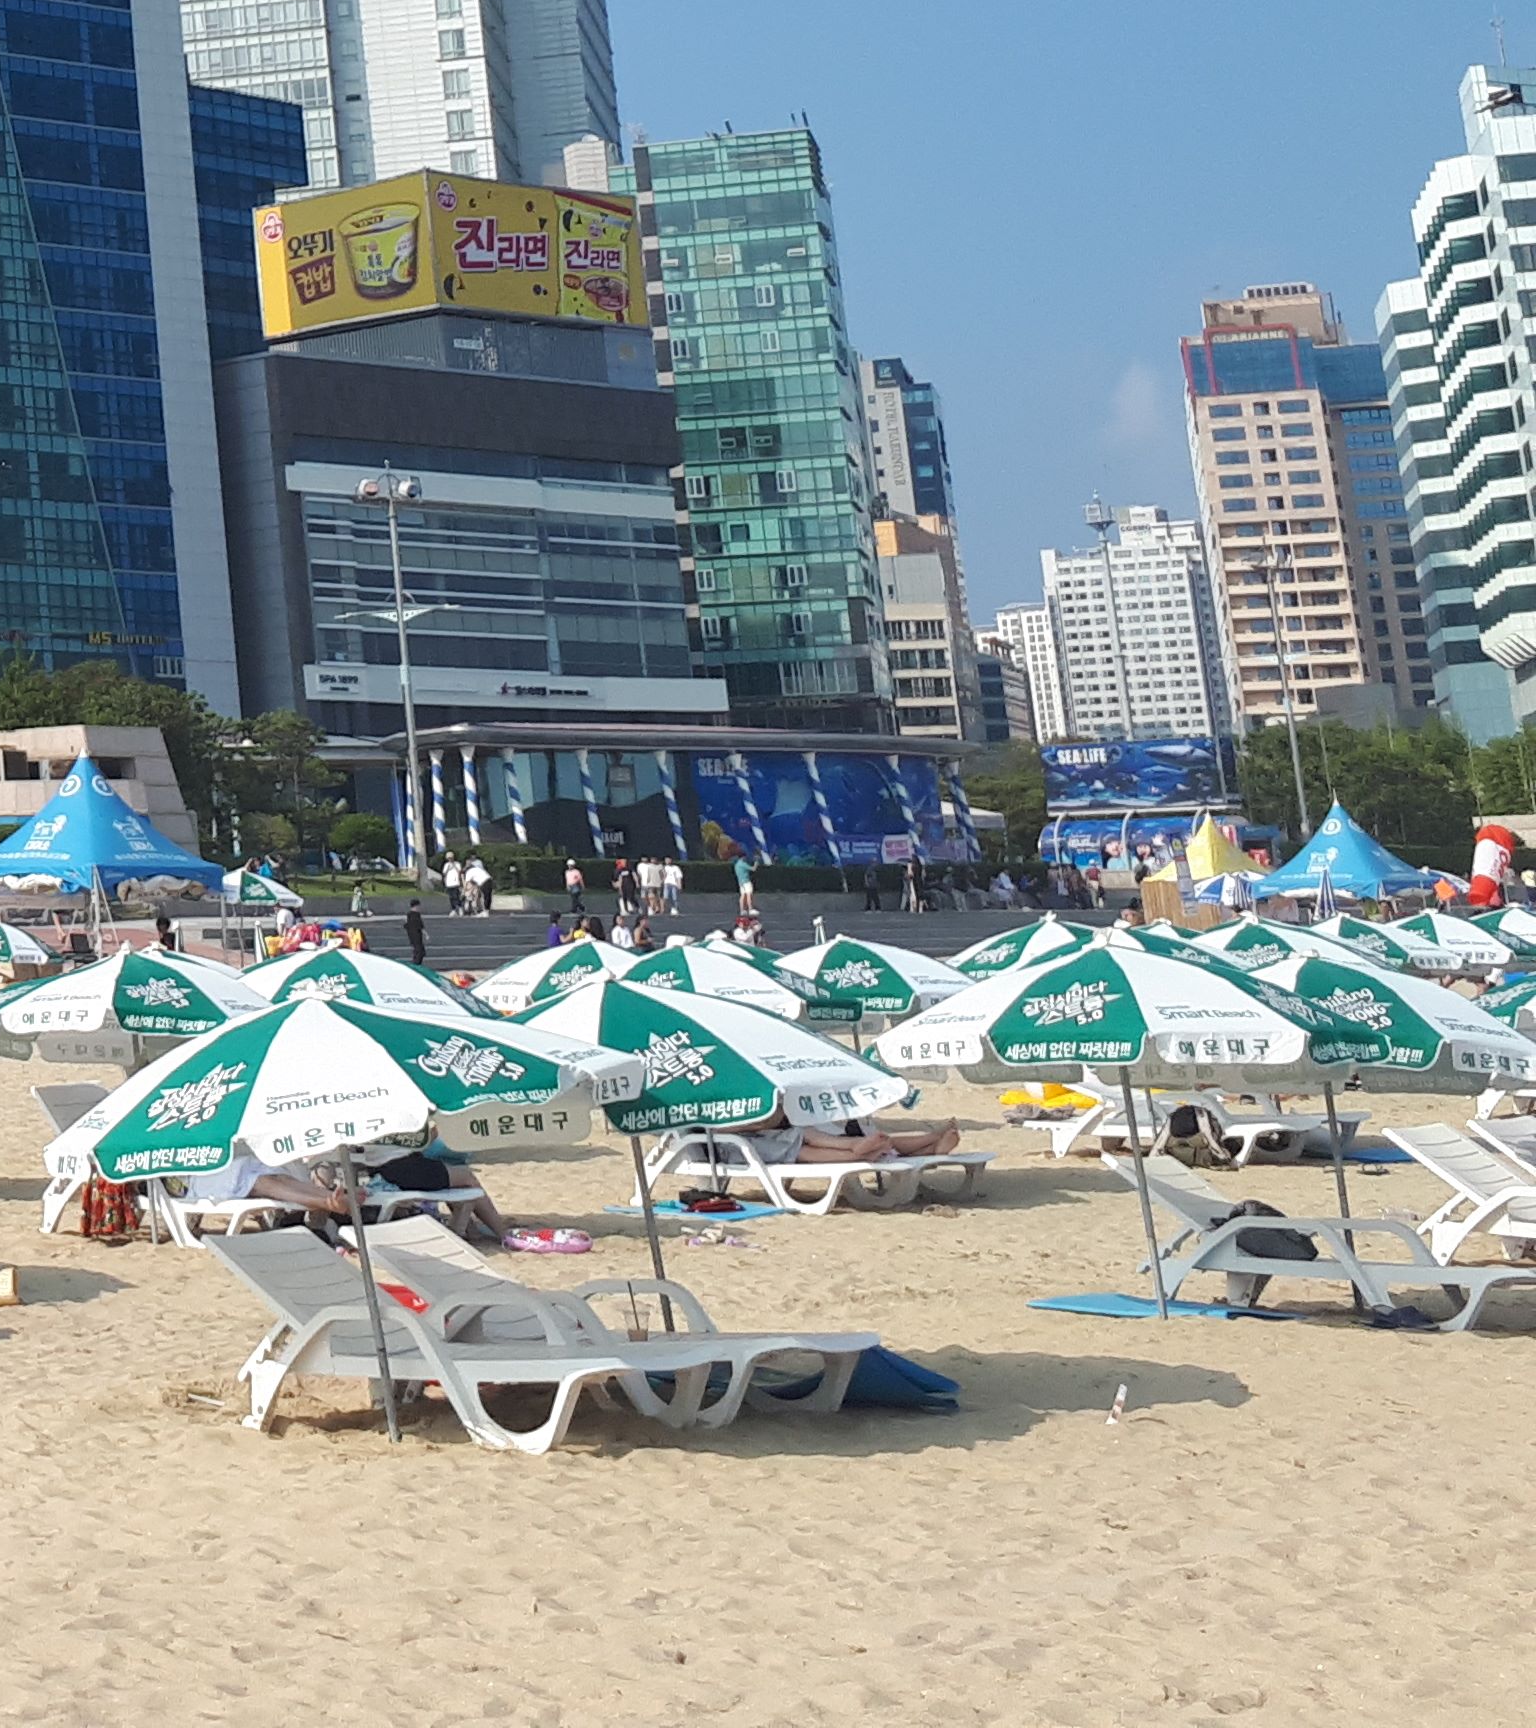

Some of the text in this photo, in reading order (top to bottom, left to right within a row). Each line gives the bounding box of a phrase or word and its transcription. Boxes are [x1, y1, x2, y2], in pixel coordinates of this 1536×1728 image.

[288, 228, 335, 260] 오뚜기
[454, 217, 548, 271] 진라면
[563, 239, 622, 270] 진라면
[295, 263, 333, 299] 컵밥
[1057, 748, 1081, 766] SEA
[1077, 1010, 1104, 1026] 5.0
[1366, 1016, 1393, 1031] 5.0
[1005, 1042, 1047, 1060] 세상에
[1049, 1042, 1076, 1058] 없던
[687, 1065, 715, 1086] 5.0
[621, 1107, 666, 1131] 세상에
[668, 1103, 699, 1121] 없던
[114, 1150, 151, 1174] 세상에
[151, 1149, 175, 1169] 없던
